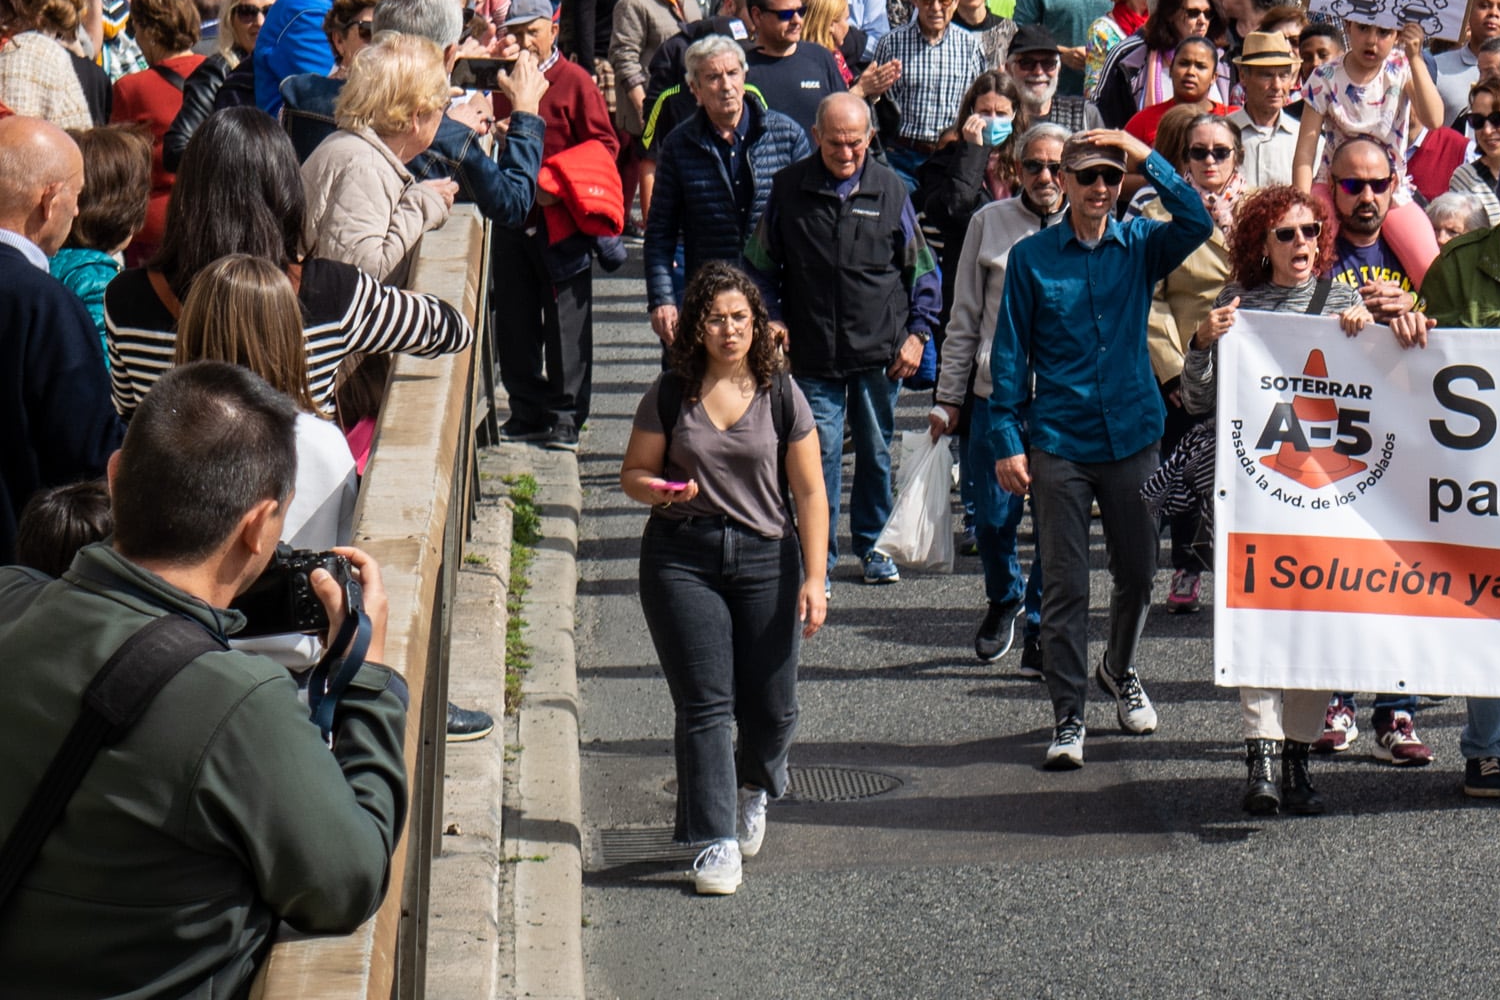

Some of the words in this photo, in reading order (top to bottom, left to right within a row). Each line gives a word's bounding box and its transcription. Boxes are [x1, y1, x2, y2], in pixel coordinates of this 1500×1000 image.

[1260, 376, 1373, 400] SOTERRAR
[1254, 402, 1373, 456] A-5
[1231, 419, 1257, 477] Pasada
[1255, 474, 1269, 491] la
[1270, 488, 1305, 509] Avd.
[1311, 497, 1330, 510] de
[1335, 491, 1357, 507] los
[1356, 432, 1396, 495] Poblados
[1270, 555, 1452, 595] Solución
